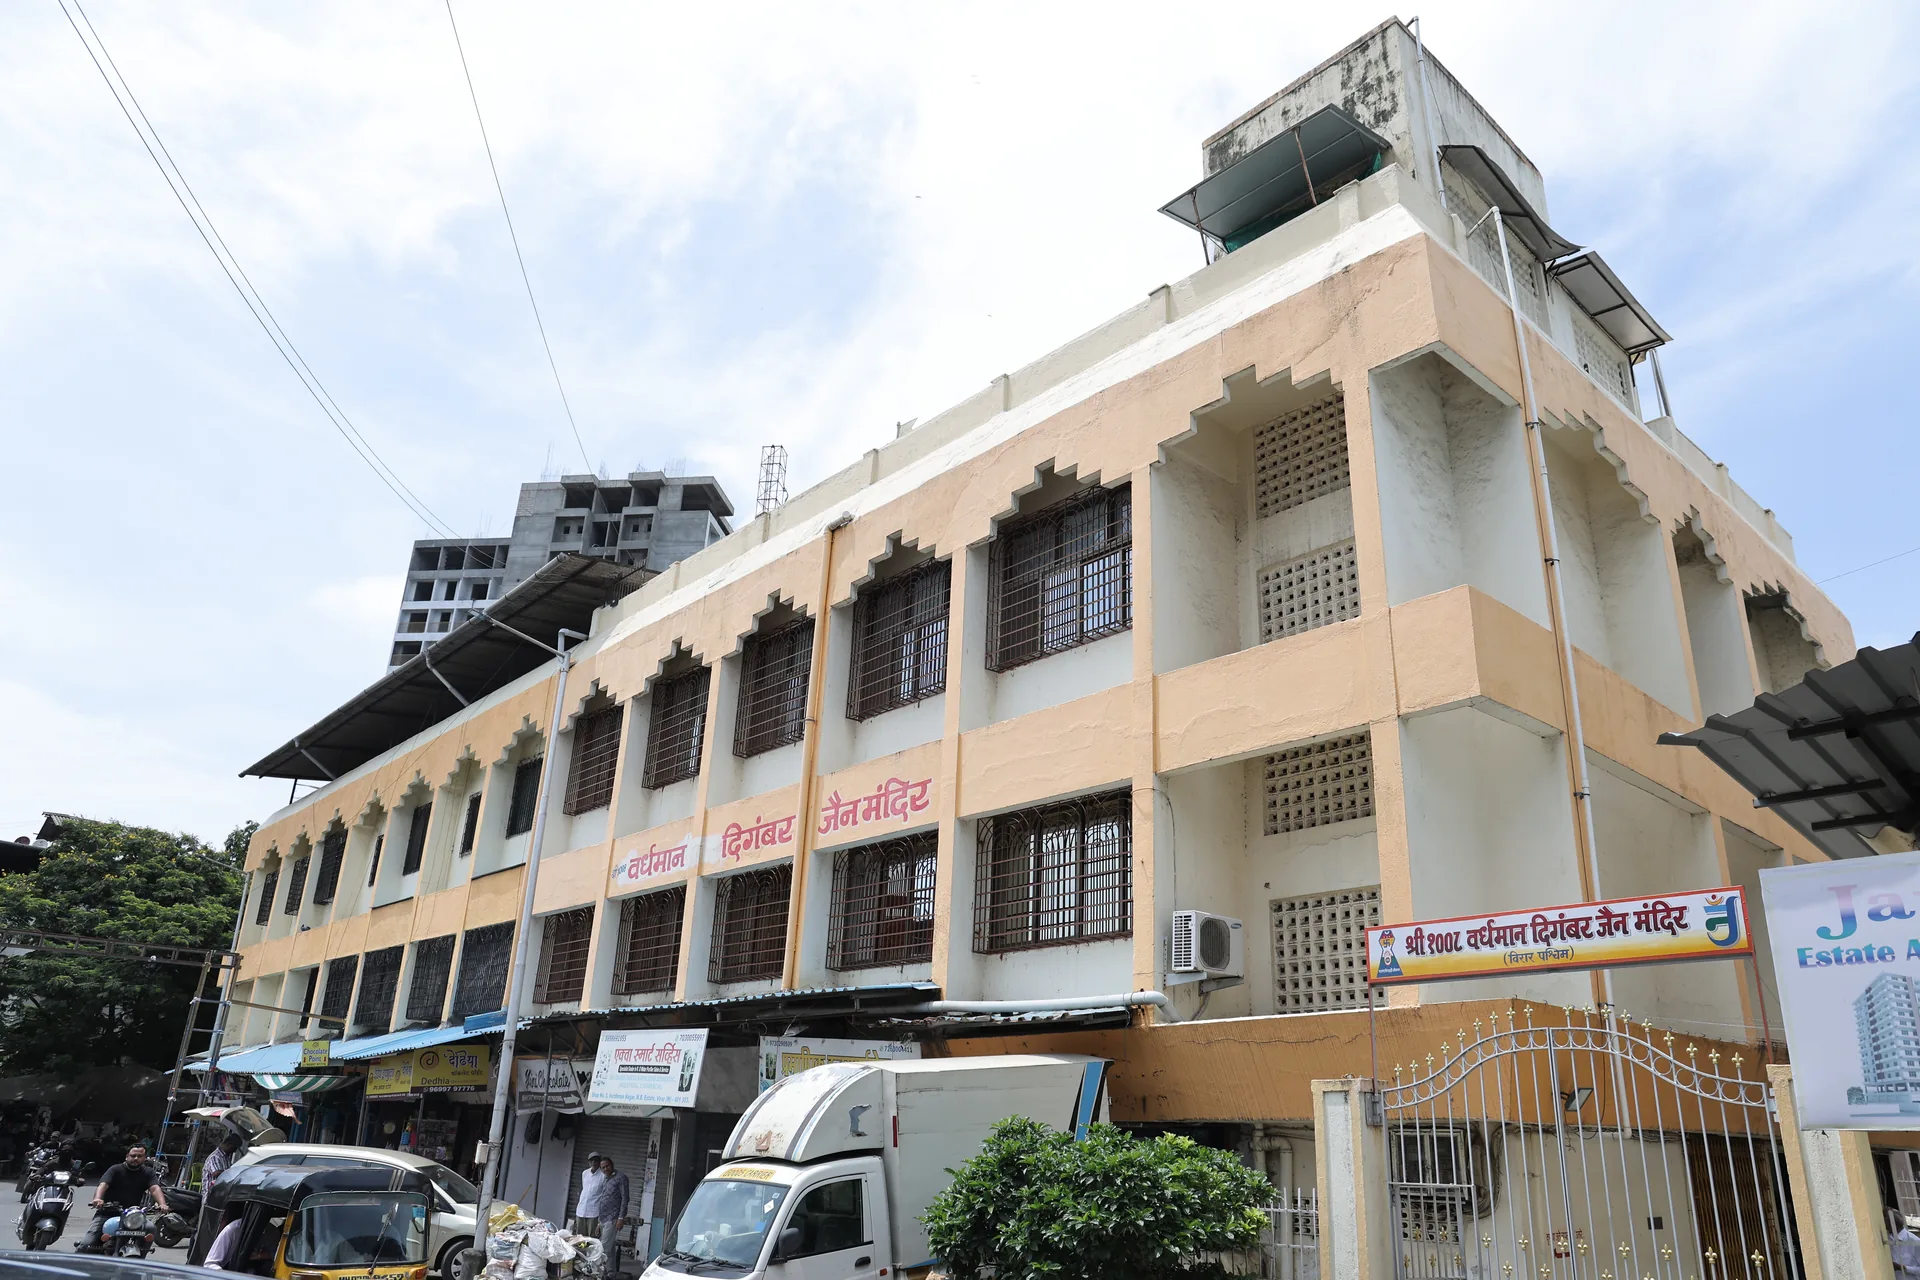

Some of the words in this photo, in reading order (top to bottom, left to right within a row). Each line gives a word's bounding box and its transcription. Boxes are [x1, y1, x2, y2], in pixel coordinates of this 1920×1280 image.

[628, 844, 687, 879] वर्धमान
[722, 815, 796, 862] दिगंबर
[818, 790, 862, 834] जैन
[862, 778, 932, 822] मंदिर
[1405, 927, 1426, 956] श्री
[1426, 931, 1463, 955] १००८
[1466, 919, 1528, 950] वर्धमान
[1530, 913, 1594, 947] दिगंबर
[1595, 905, 1629, 937] जैन
[1633, 900, 1688, 935] मंदिर
[1816, 884, 1920, 940] Ja
[1797, 944, 1896, 969] Estate
[634, 1042, 656, 1062] स्मार्ट
[421, 1077, 449, 1085] Dedhia
